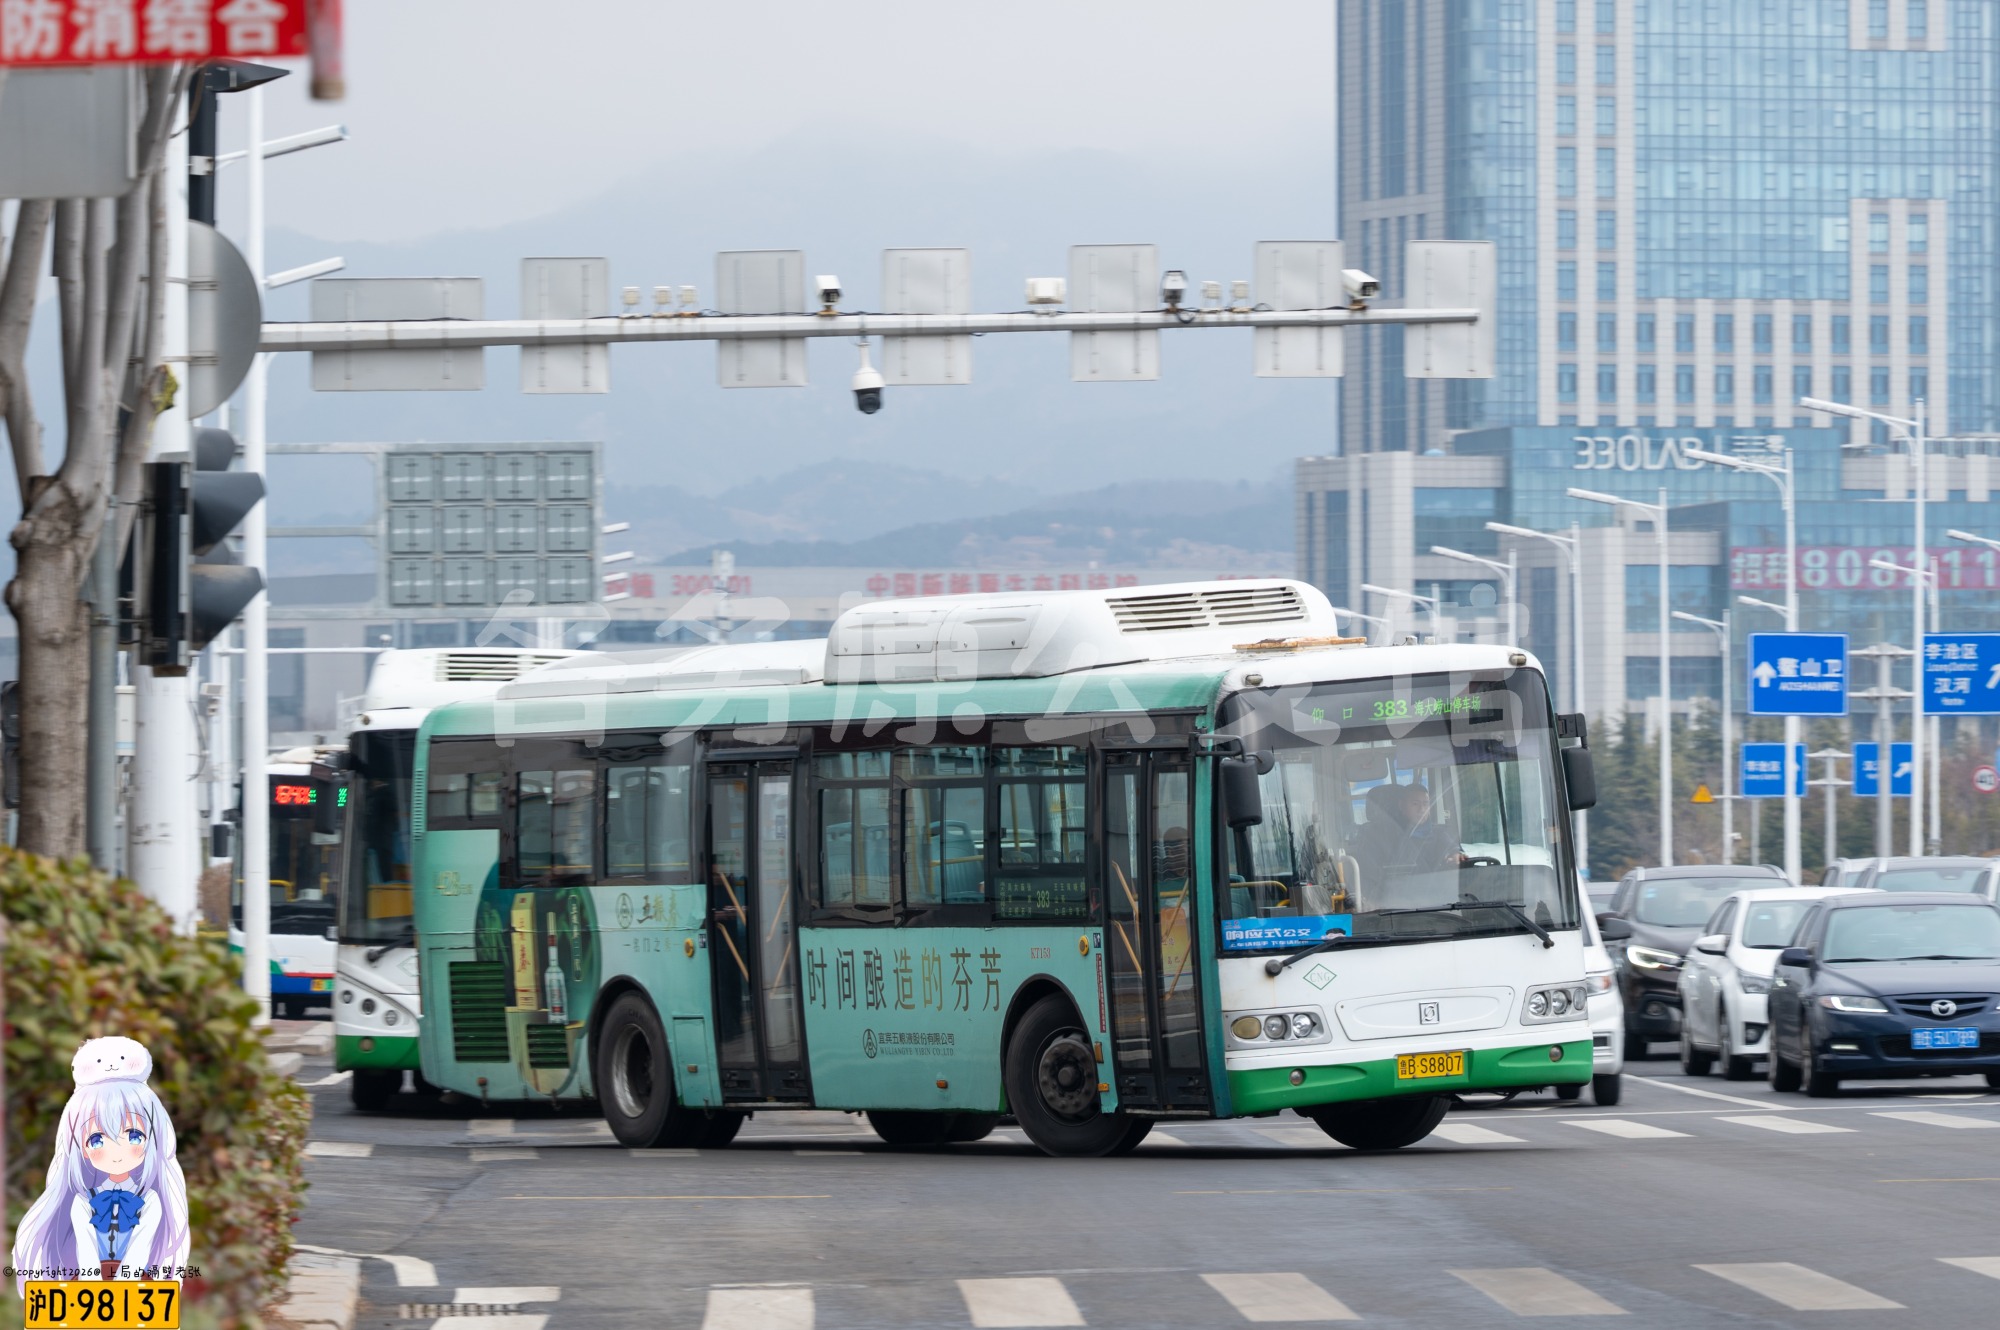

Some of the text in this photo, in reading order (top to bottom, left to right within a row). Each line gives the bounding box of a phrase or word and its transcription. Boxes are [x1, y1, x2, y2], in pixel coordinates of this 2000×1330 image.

[2, 0, 287, 58] 防消结合
[1374, 700, 1408, 717] 383
[1414, 695, 1482, 716] 海大崂山停车场
[1036, 890, 1050, 909] 383
[1226, 928, 1311, 941] 响应式公交
[806, 946, 1002, 1012] 时间酿造的芬芳
[1310, 972, 1330, 983] CNG
[878, 1032, 955, 1046] 宜宾五粮液股份有限公司
